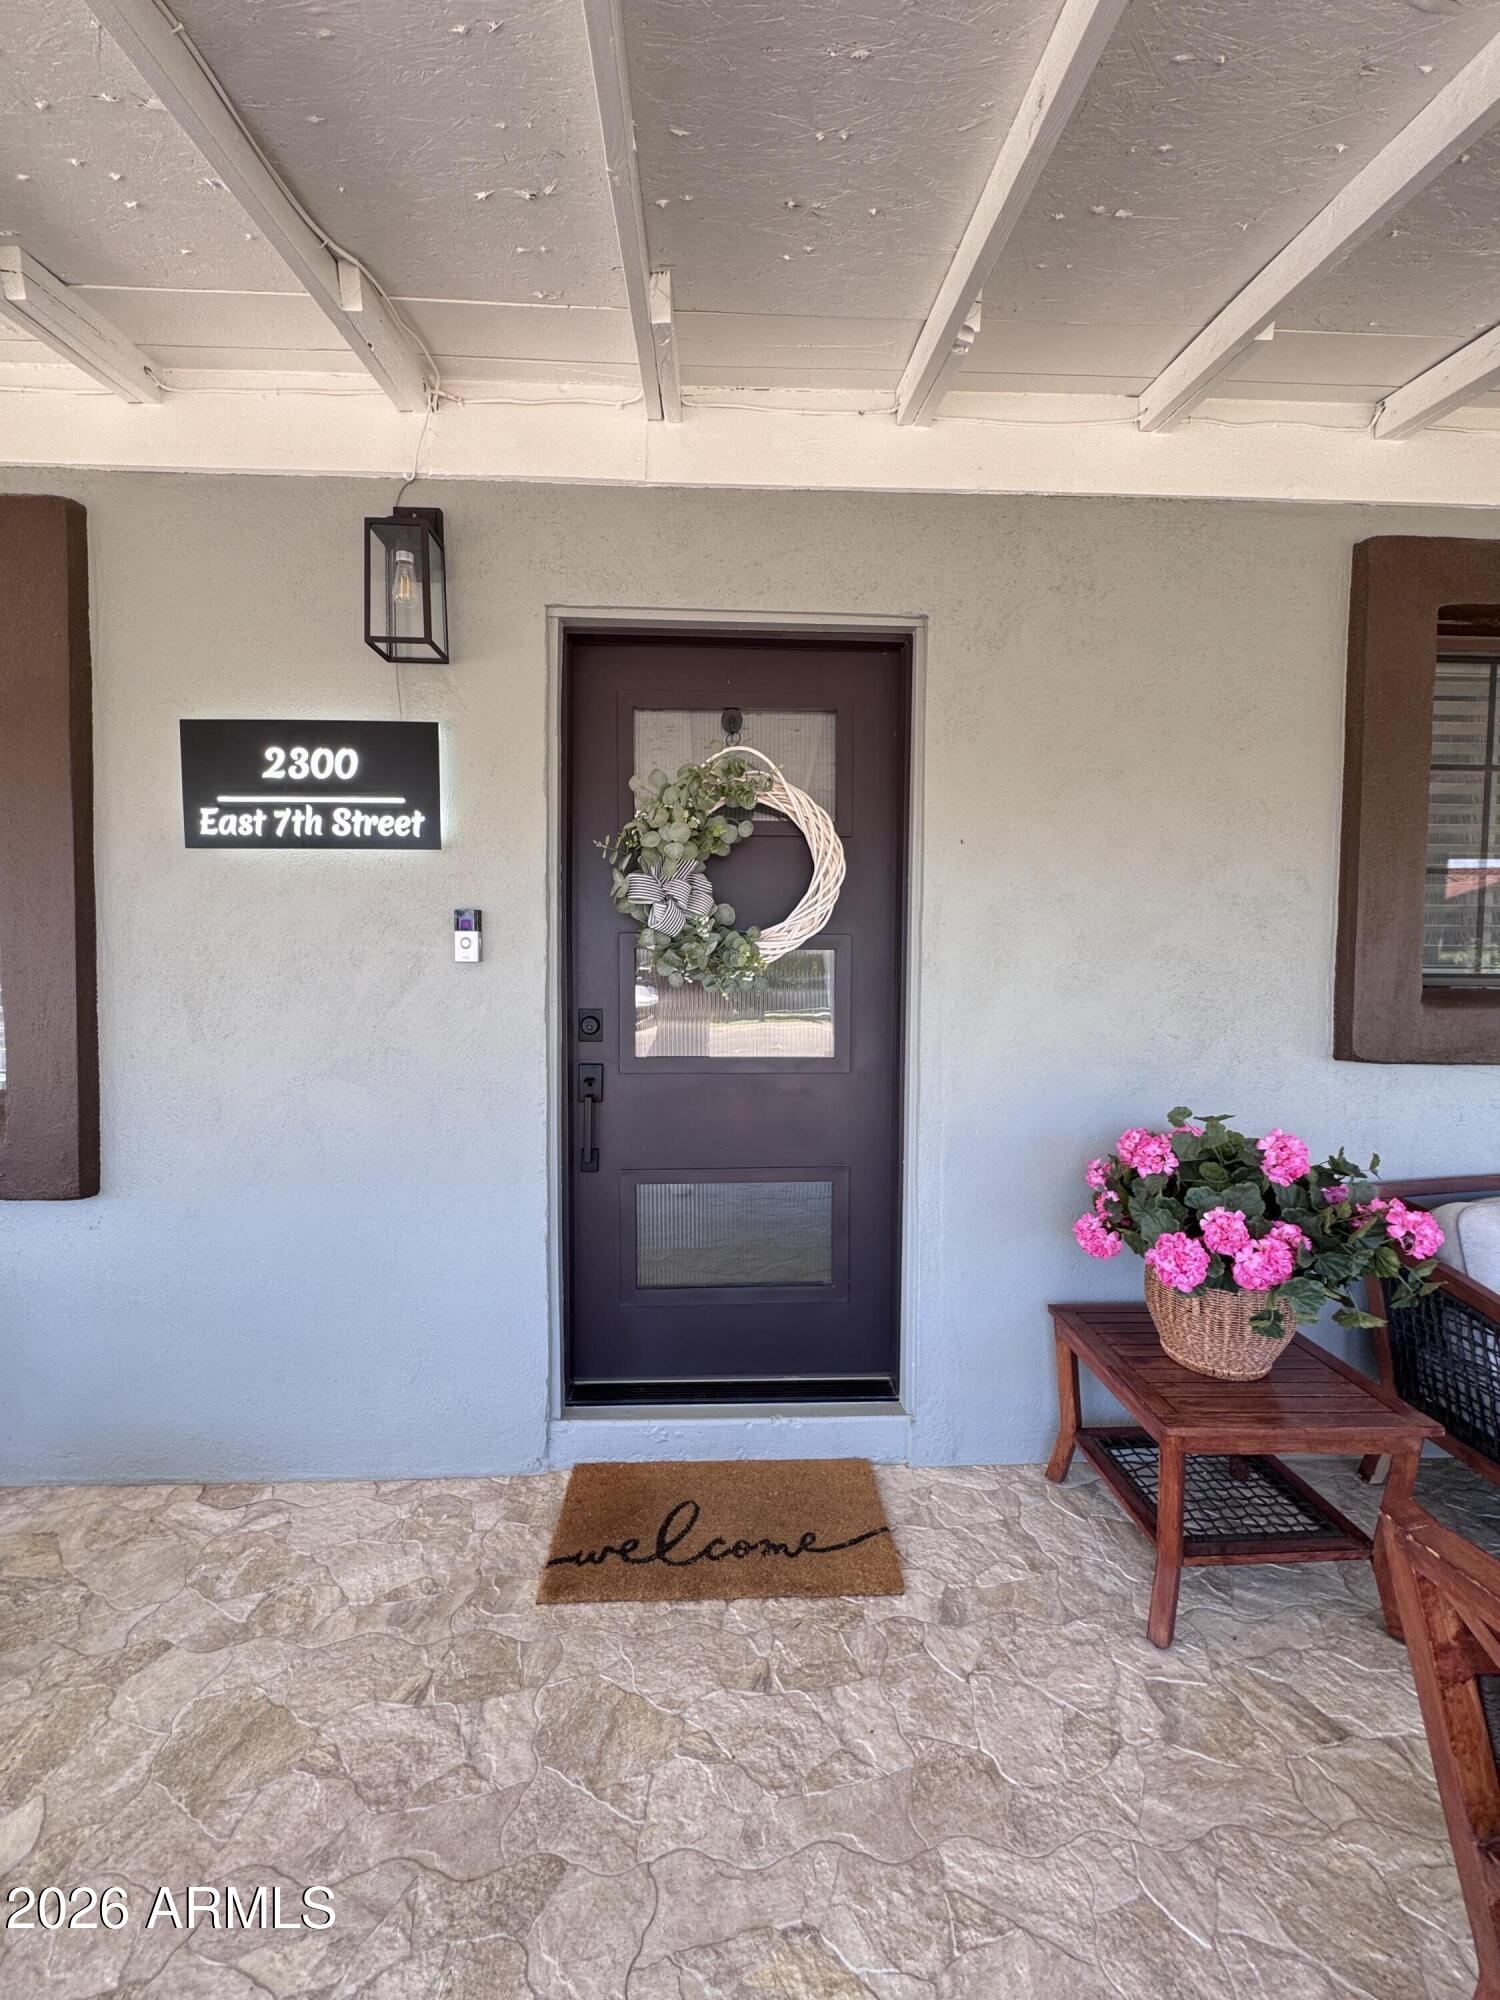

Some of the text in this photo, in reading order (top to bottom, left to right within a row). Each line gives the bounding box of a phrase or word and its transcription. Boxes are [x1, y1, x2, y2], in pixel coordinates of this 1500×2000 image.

[261, 746, 359, 780] 2300
[199, 804, 426, 838] East 7th Street
[545, 1499, 890, 1568] welcome
